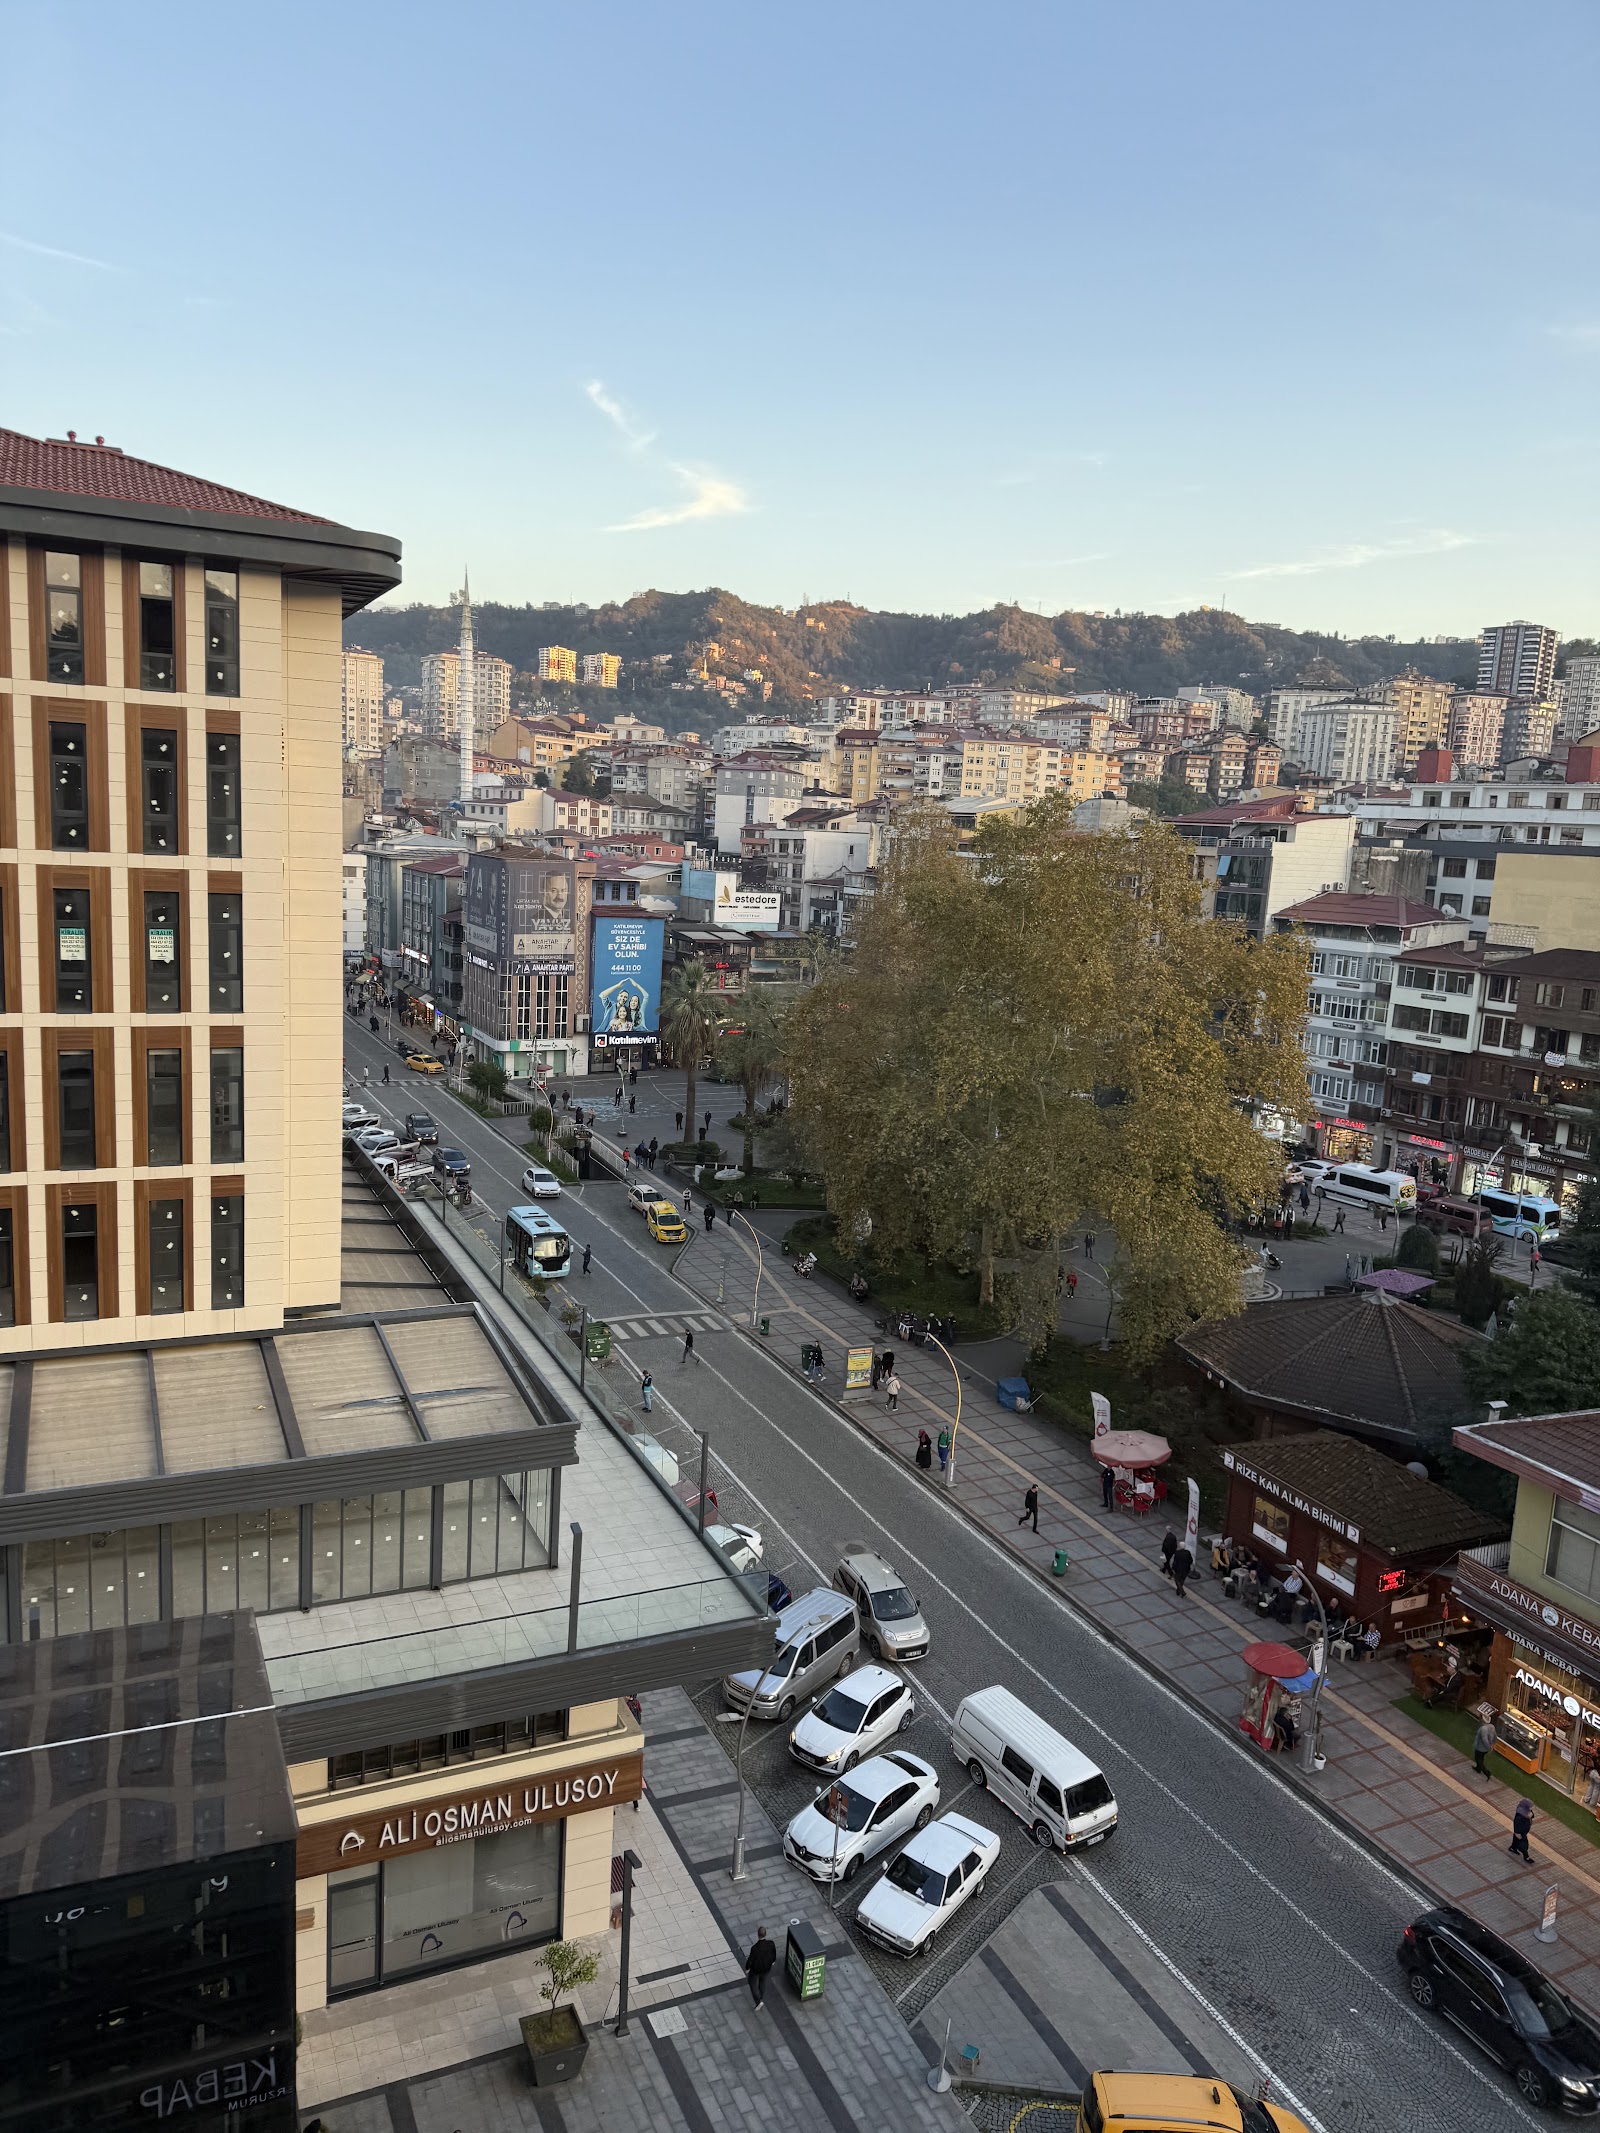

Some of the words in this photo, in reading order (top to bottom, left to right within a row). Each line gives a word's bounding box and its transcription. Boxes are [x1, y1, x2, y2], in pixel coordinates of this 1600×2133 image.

[735, 894, 777, 905] estedore
[615, 935, 628, 943] SİZ
[532, 964, 558, 972] ANAHTAR
[609, 1035, 657, 1045] Katılımevim
[1335, 1117, 1366, 1129] ECZANE
[1410, 1134, 1444, 1148] ECZANE
[1236, 1462, 1258, 1483] RİZE
[1259, 1475, 1280, 1497] KAN
[1281, 1490, 1310, 1515] ALMA
[1312, 1507, 1345, 1535] BİRİMİ
[1490, 1579, 1539, 1616] ADANA
[1505, 1630, 1541, 1656] ADANA
[1543, 1650, 1581, 1678] KEBAP
[1515, 1668, 1562, 1706] ADANA
[378, 1809, 418, 1849] ALİ
[424, 1794, 513, 1838] OSMAN
[524, 1769, 619, 1814] ULUSOY
[435, 1816, 533, 1847] aliosmanulusoy.com
